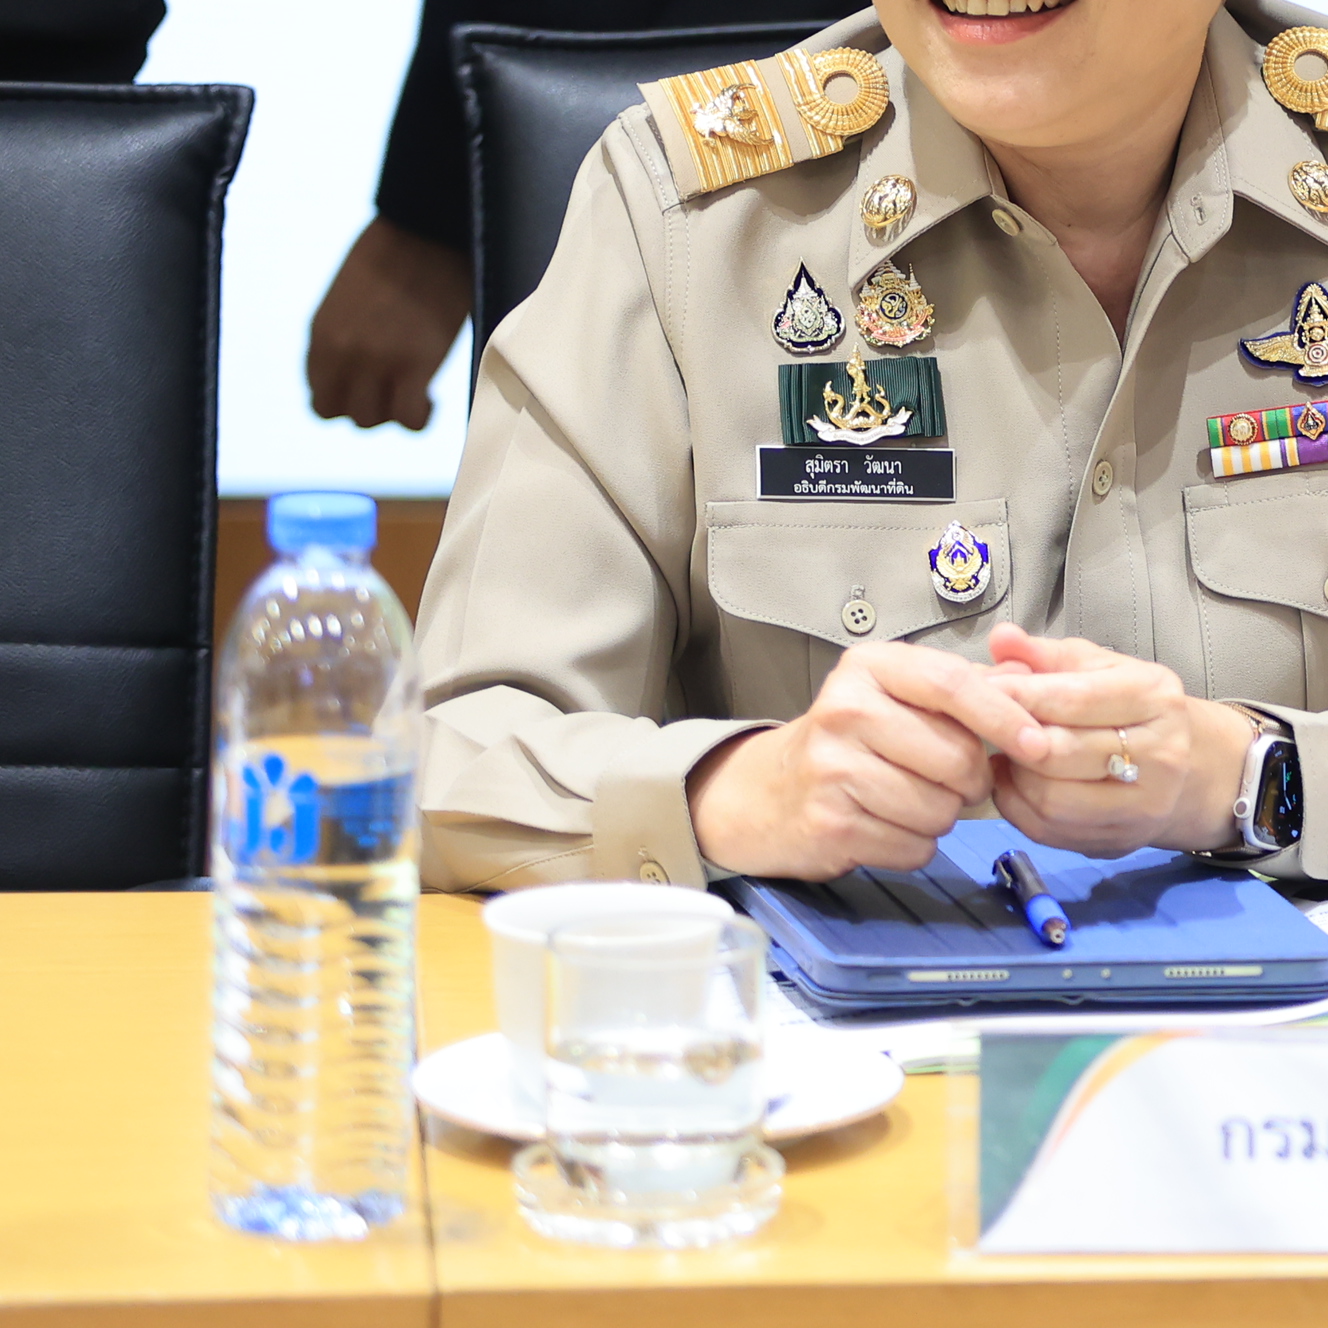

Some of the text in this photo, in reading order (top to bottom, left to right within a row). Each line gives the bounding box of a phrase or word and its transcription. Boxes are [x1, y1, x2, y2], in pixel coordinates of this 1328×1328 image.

[804, 453, 902, 480] สุมิตรา วัฒนา
[793, 477, 914, 495] อธิบดีกรมพัฒนาที่ดิน
